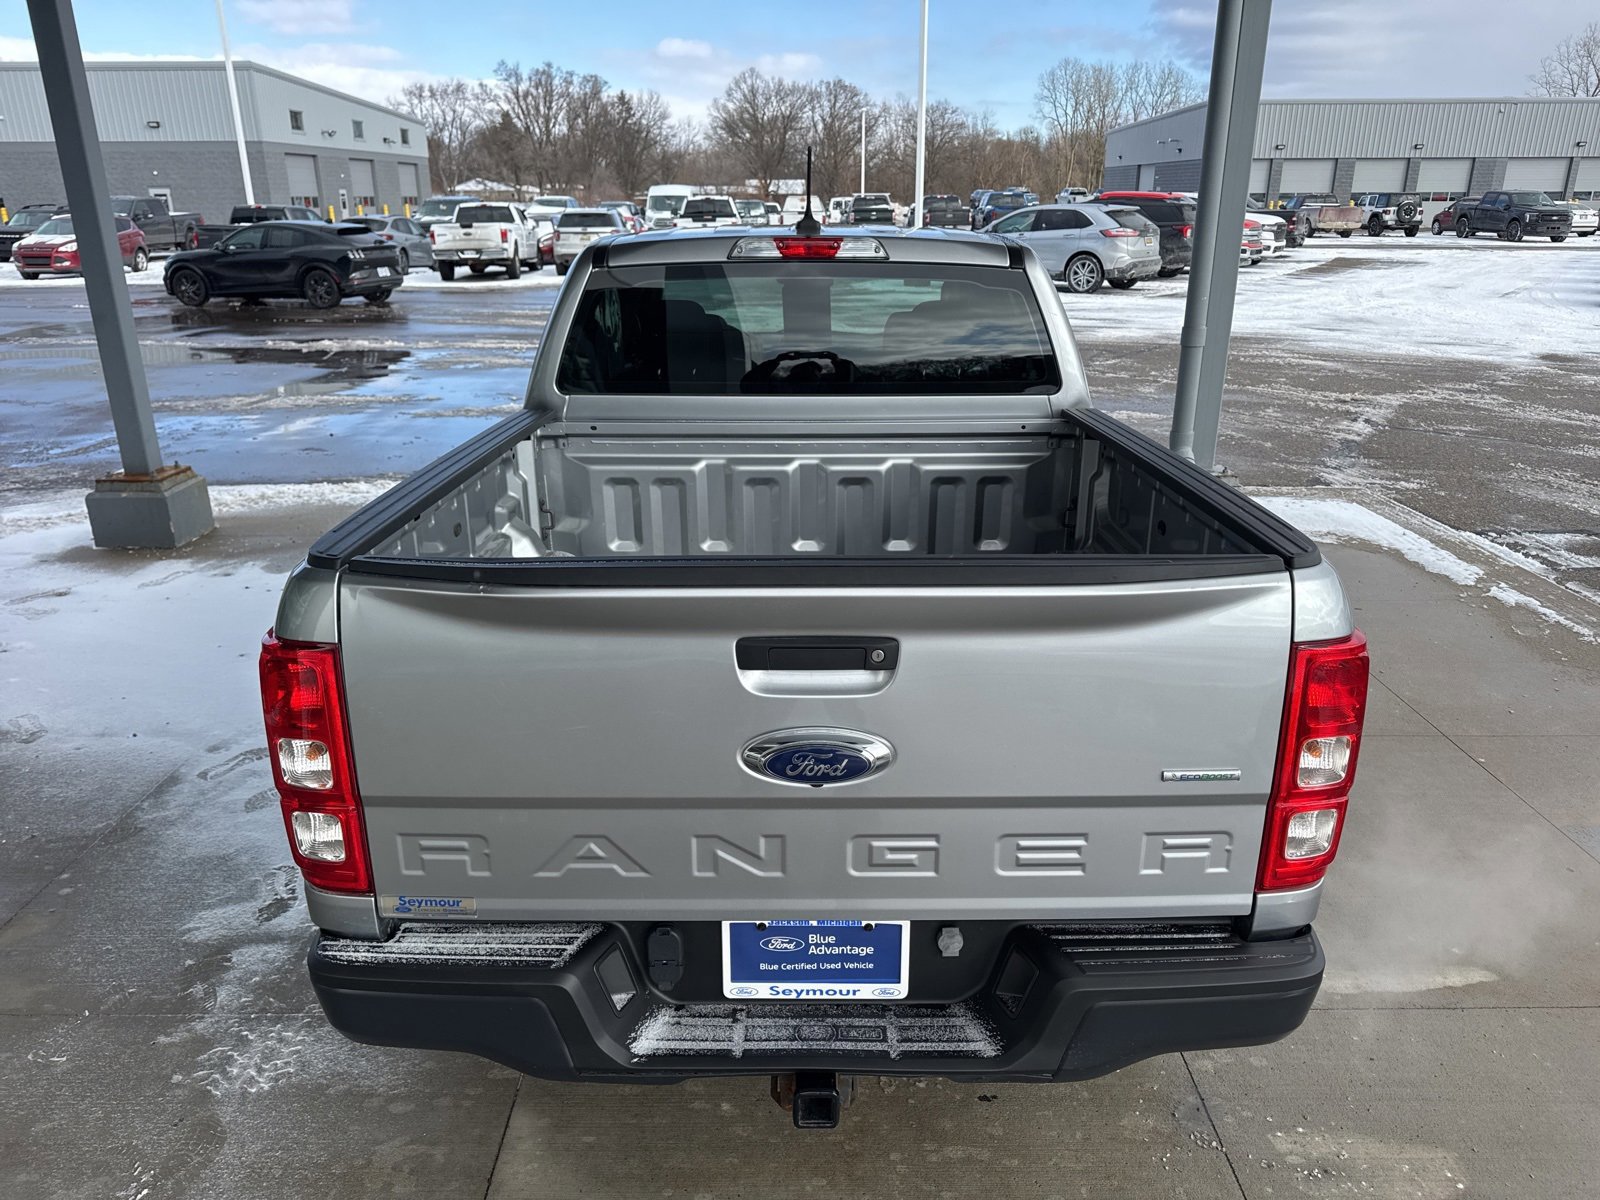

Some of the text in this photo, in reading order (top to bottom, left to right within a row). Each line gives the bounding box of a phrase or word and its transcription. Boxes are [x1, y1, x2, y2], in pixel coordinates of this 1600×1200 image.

[785, 752, 848, 777] Ford
[396, 832, 1234, 877] RANGER
[398, 895, 462, 908] Seymour
[768, 938, 797, 950] Ford
[808, 933, 836, 944] Blue
[808, 945, 875, 956] Advantage
[759, 961, 874, 970] Blue Certified Used Vehicle
[769, 985, 861, 998] Seymour
